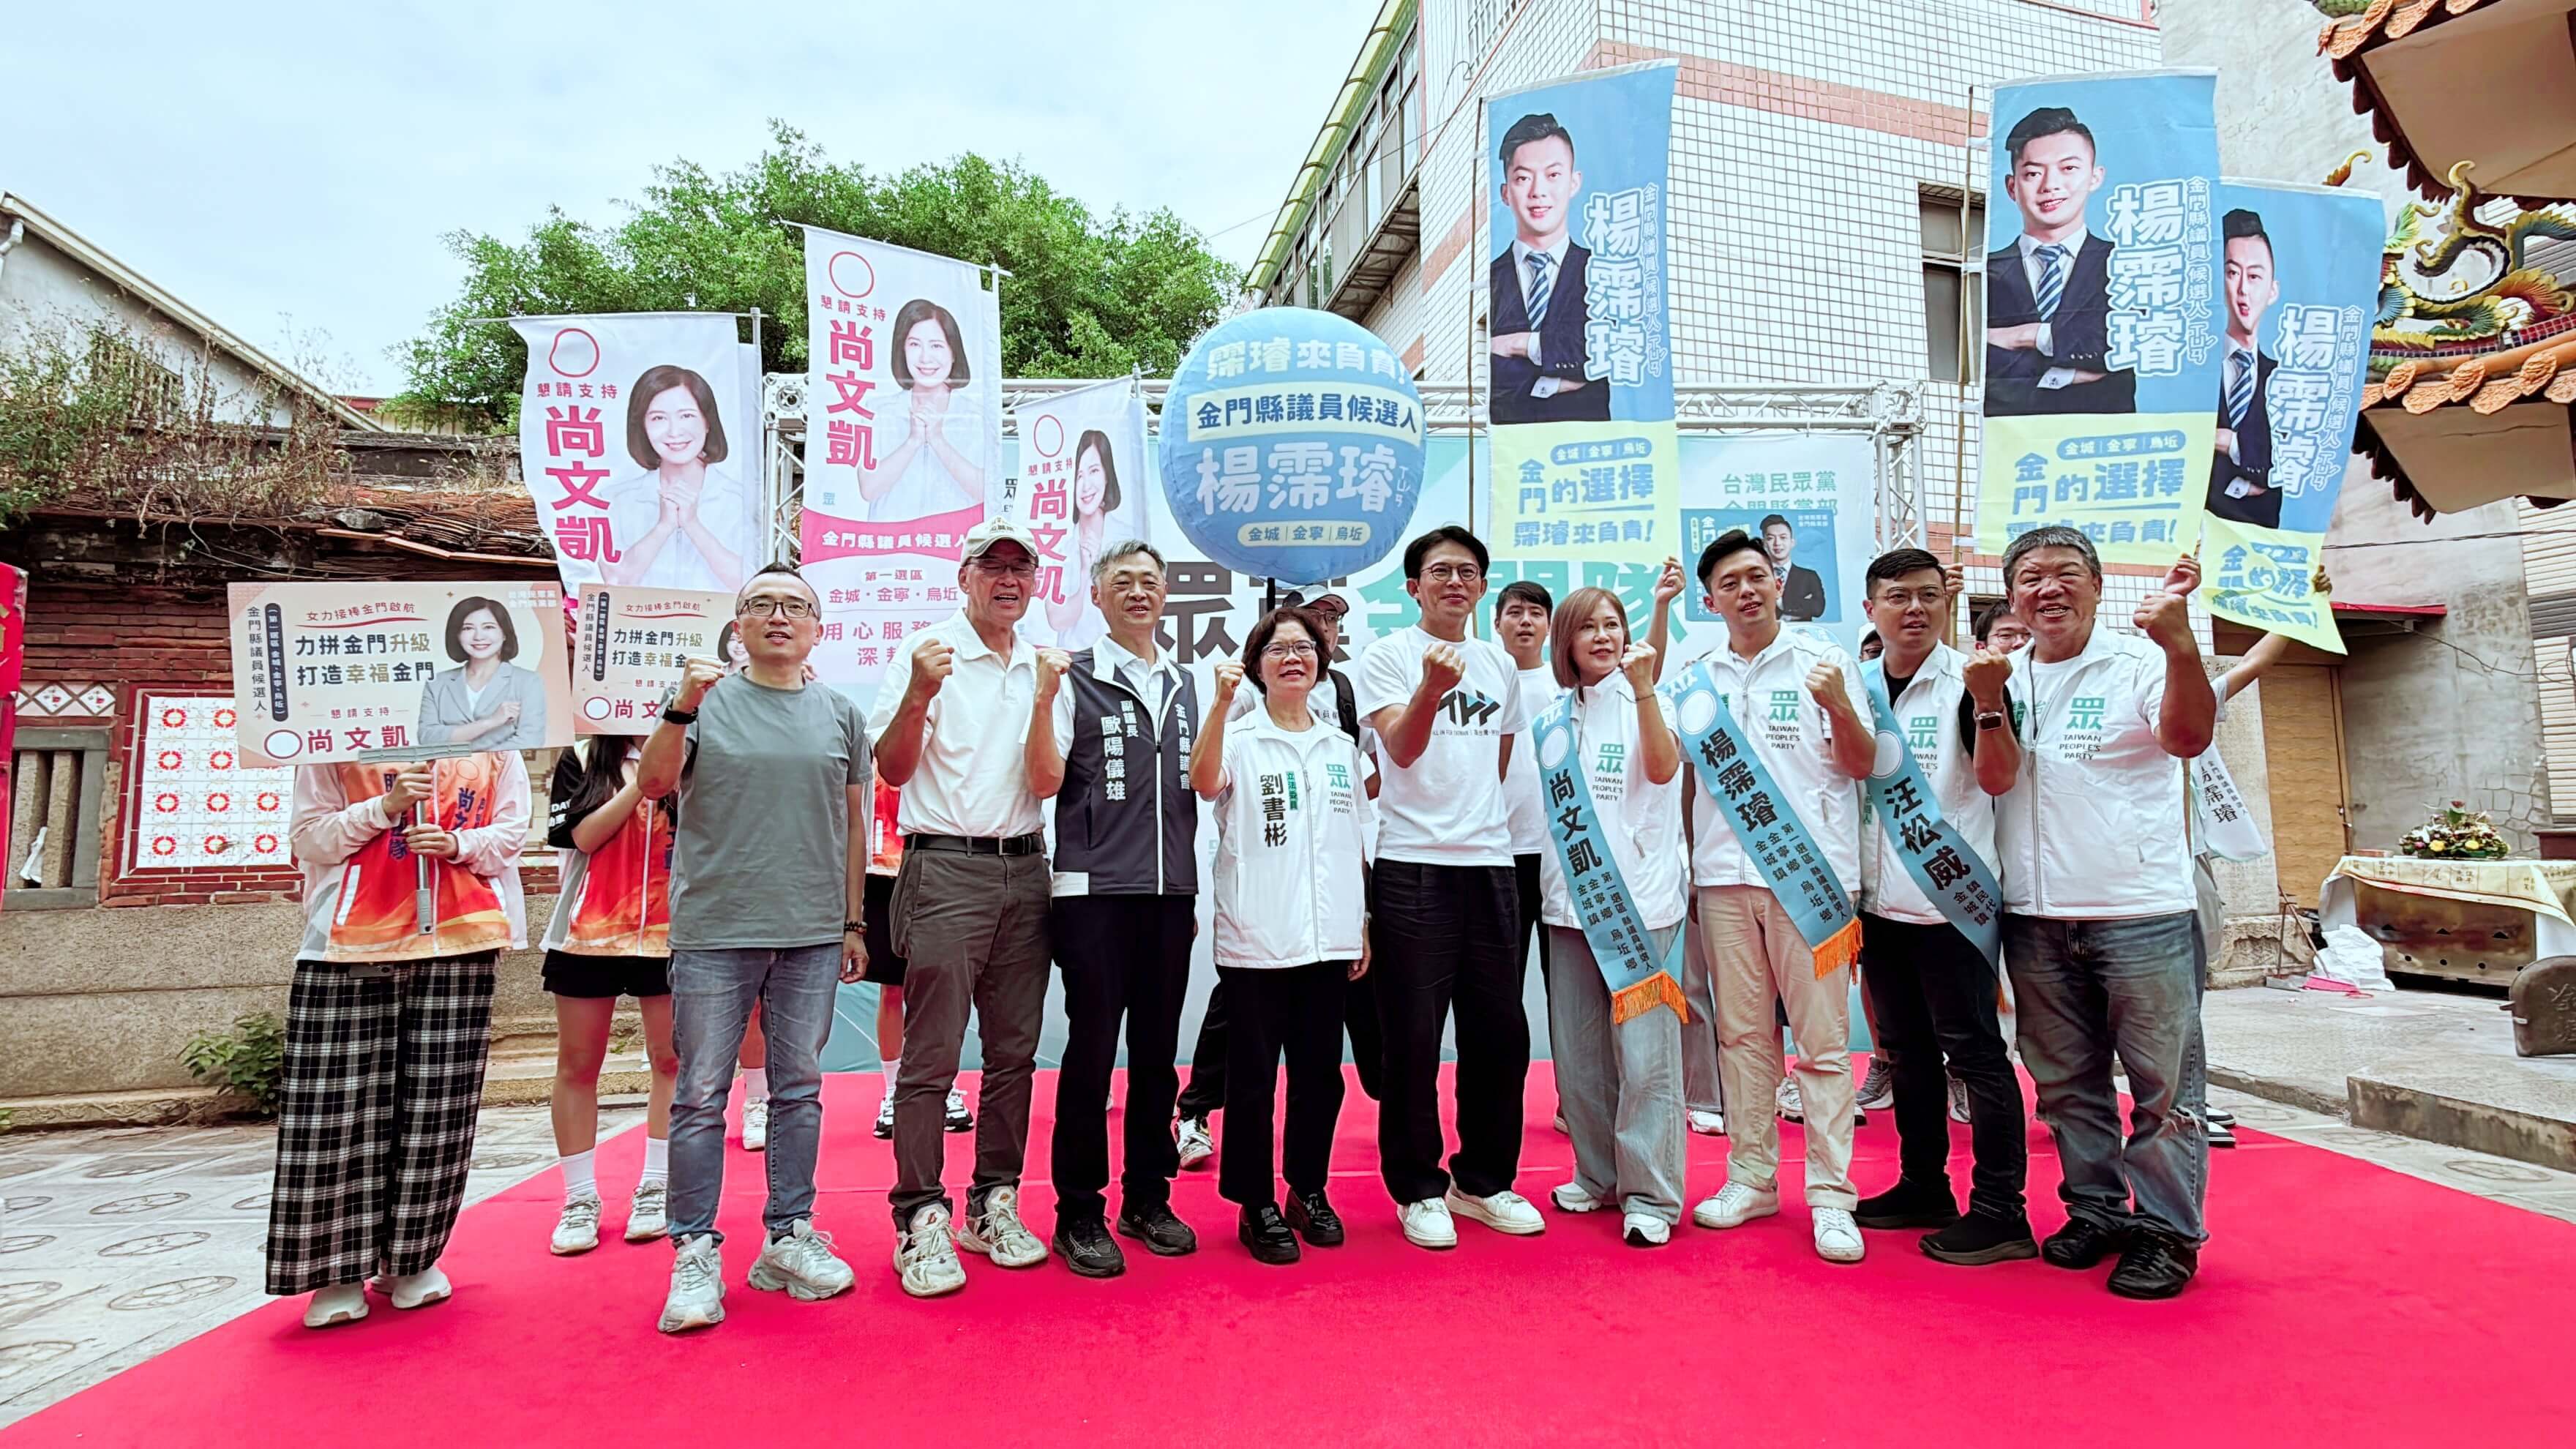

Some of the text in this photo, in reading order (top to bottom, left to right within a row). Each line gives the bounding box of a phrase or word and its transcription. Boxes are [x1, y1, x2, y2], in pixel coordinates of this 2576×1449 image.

[2187, 179, 2209, 316] 金門縣議員候選人
[820, 294, 886, 322] 懇請支持
[536, 382, 618, 400] 懇請支持
[825, 320, 877, 471] 尚文凱
[1197, 393, 1418, 433] 金門縣議員候選人
[1556, 447, 1579, 461] 金城
[2065, 441, 2094, 455] 金城
[1027, 457, 1073, 476] 懇請支持
[545, 405, 621, 563] 尚文凱
[1519, 458, 1654, 514] 金門的選擇
[1721, 471, 1838, 495] 台灣民眾黨
[2012, 452, 2185, 515] 金門的選擇
[1248, 527, 1280, 542] 金城
[1292, 525, 1323, 542] 金寧
[865, 569, 924, 582] 第一選區
[295, 632, 432, 657] 力拼金門升級
[614, 628, 703, 648] 力拼金門升級
[247, 606, 267, 712] 金門縣議員候選人
[297, 661, 435, 687] 打造幸福金門
[331, 706, 391, 719] 懇請支持
[1765, 733, 1801, 742] PEOPLE'S
[1769, 724, 1800, 733] TAIWAN
[307, 724, 410, 755] 尚文凱
[1771, 742, 1796, 750] PARTY
[2059, 744, 2102, 752] PEOPLE'S
[2063, 734, 2102, 743] TAIWAN
[1100, 714, 1126, 801] 歐陽儀雄
[2064, 752, 2094, 760] PARTY
[1592, 785, 1624, 794] PEOPLE'S
[1594, 776, 1623, 785] TAIWAN
[1330, 791, 1352, 799] TAIWAN
[1595, 793, 1620, 802] PARTY
[1259, 773, 1288, 848] 劉書彬
[1549, 768, 1602, 878] 尚文凱
[1884, 776, 1971, 891] 汪松威
